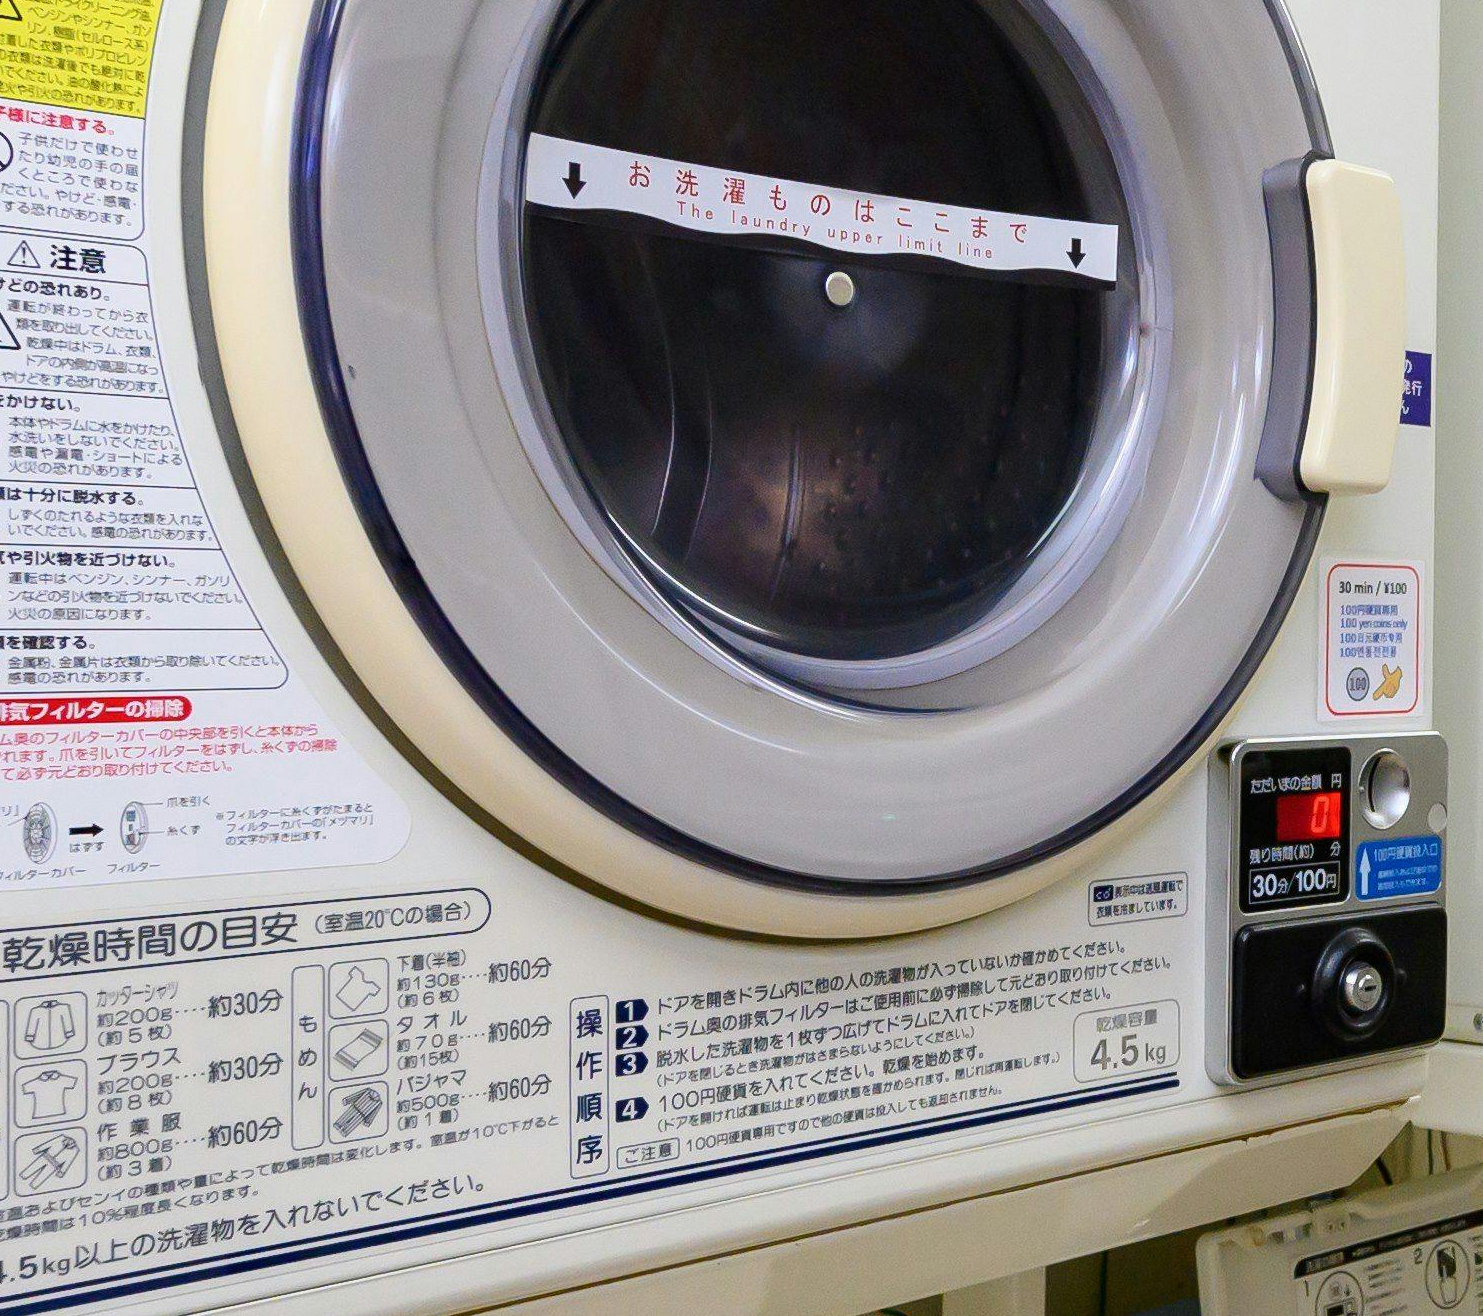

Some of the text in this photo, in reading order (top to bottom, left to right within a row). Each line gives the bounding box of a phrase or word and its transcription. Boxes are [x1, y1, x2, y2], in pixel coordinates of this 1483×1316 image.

[19, 167, 138, 193] くところで使わな
[629, 160, 1027, 244] お洗濯ものはここまで
[678, 201, 993, 259] The laundry upper limit line
[50, 245, 106, 274] 注意
[1339, 581, 1351, 594] 30
[1354, 584, 1373, 594] min
[1384, 583, 1406, 594] ¥100
[1340, 618, 1357, 628] 100
[1359, 620, 1372, 630] yen
[1393, 619, 1407, 630] only
[1251, 774, 1341, 794] ただいまの金額 円
[1330, 842, 1341, 857] 分
[107, 861, 161, 875] フィルター
[1, 911, 299, 973] 乾燥時間の目安
[488, 956, 552, 985] 約60分
[208, 989, 284, 1020] 約30分
[488, 1015, 552, 1044] 約60分
[1090, 1033, 1137, 1071] 4.5
[208, 1053, 284, 1084] 約30分
[488, 1074, 552, 1104] 約60分
[575, 1009, 603, 1165] 操作順序
[208, 1116, 284, 1150] 約60分
[623, 1141, 673, 1164] ご注意
